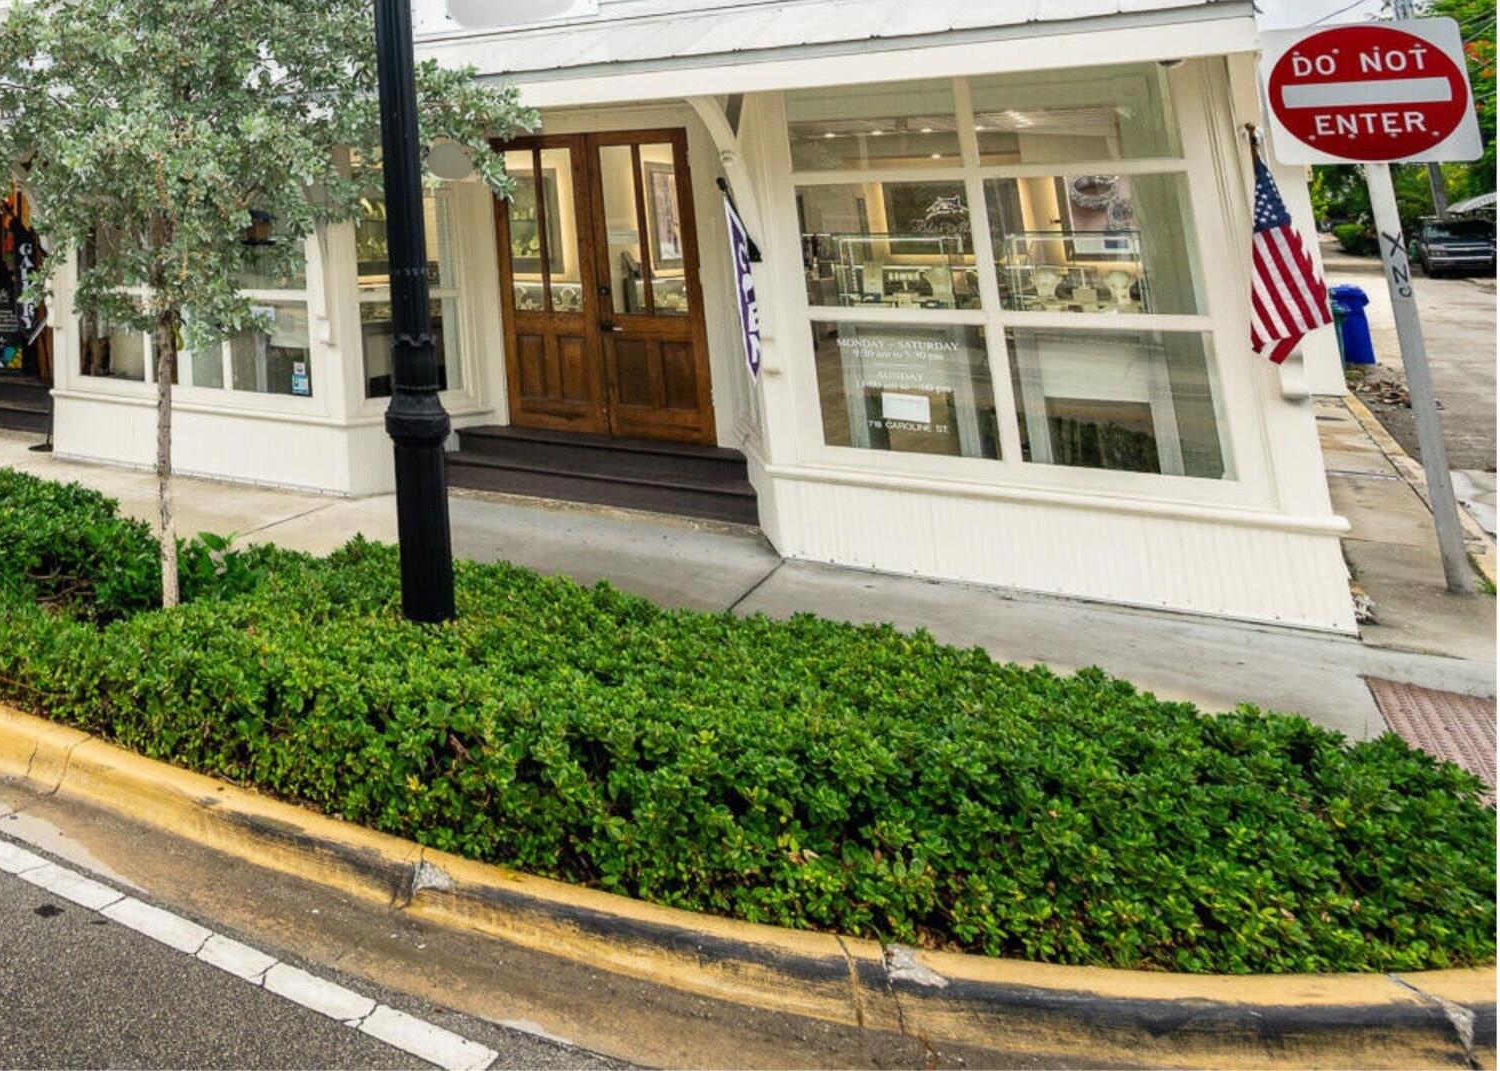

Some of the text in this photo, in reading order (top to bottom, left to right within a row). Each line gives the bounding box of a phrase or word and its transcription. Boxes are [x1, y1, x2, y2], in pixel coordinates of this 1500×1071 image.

[1292, 48, 1427, 77] DO NOT
[1314, 111, 1427, 135] ENTER
[836, 337, 885, 348] MONDAY
[897, 340, 959, 351] SATURDAY
[876, 370, 925, 381] SUNDAY
[885, 419, 932, 432] CAROLINE
